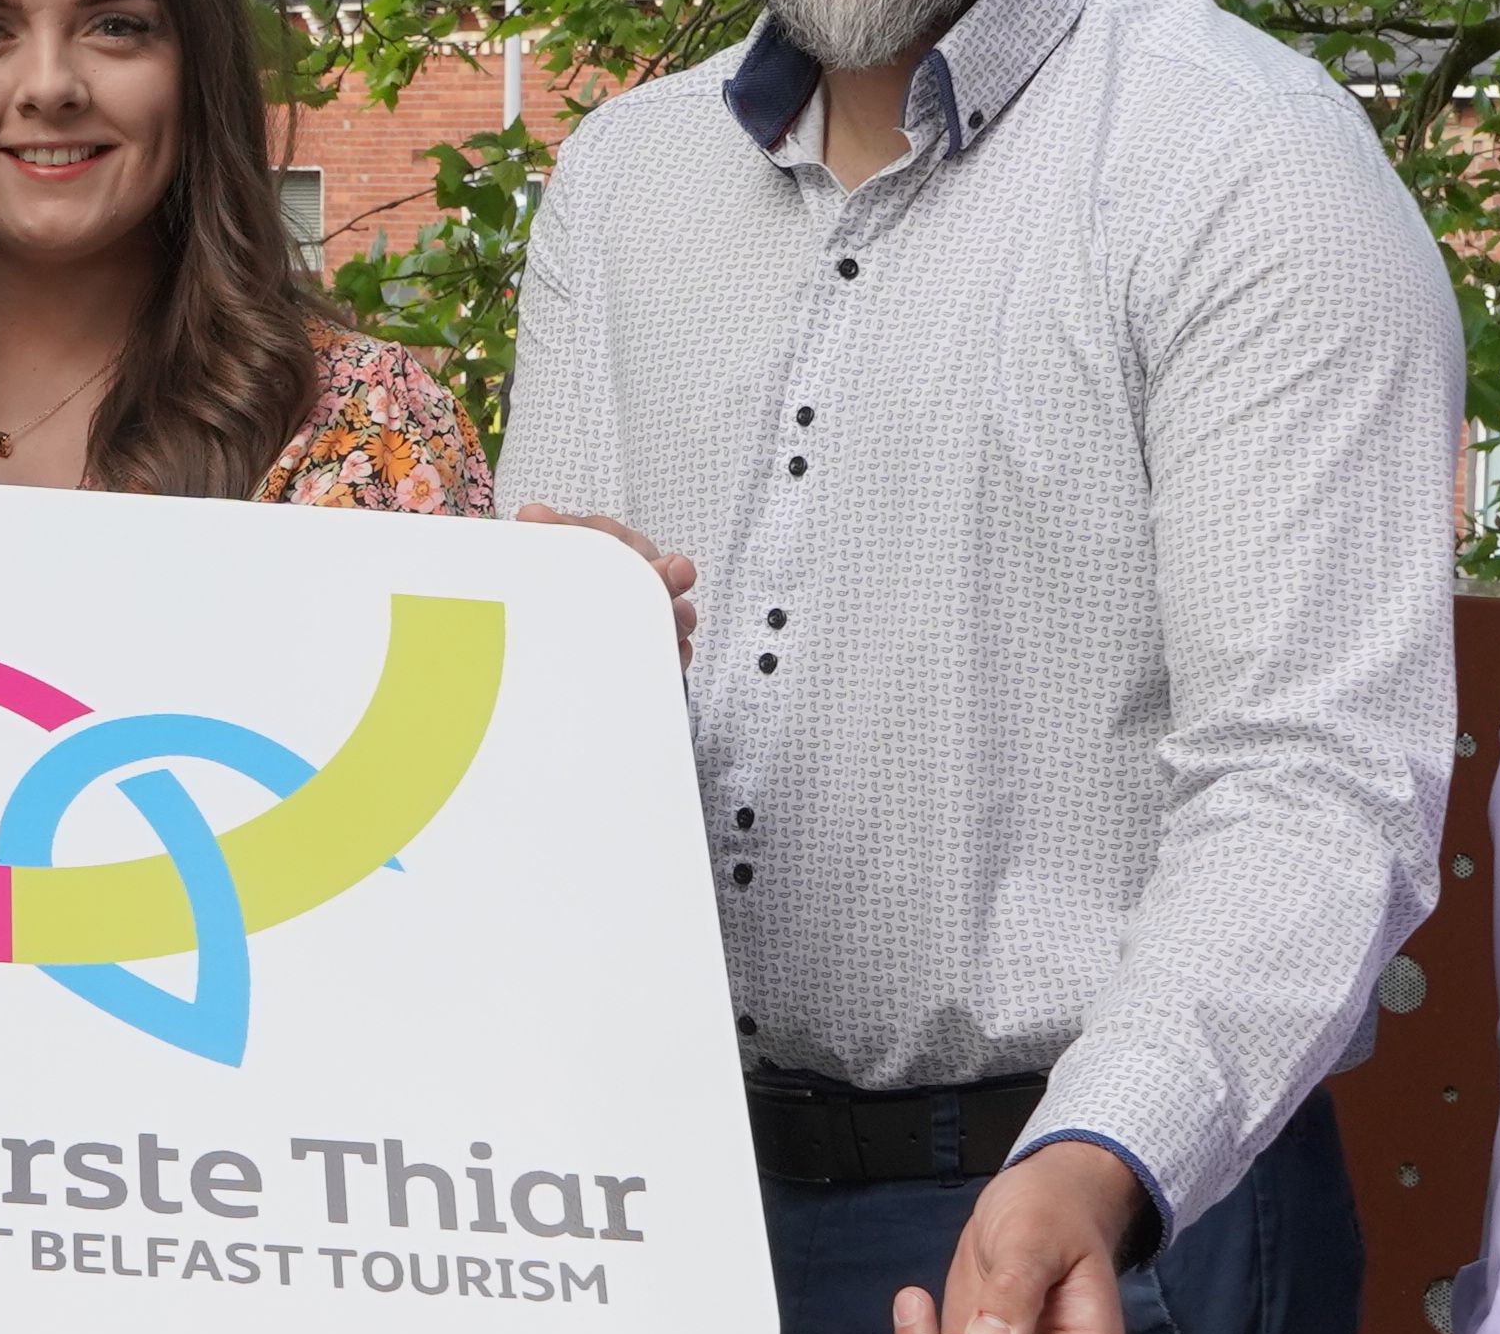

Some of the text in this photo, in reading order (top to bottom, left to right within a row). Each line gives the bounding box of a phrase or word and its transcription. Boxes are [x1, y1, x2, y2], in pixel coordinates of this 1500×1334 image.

[290, 1137, 647, 1243] Thiar
[31, 1229, 304, 1286] BELFAST
[317, 1247, 609, 1305] TOURISM
